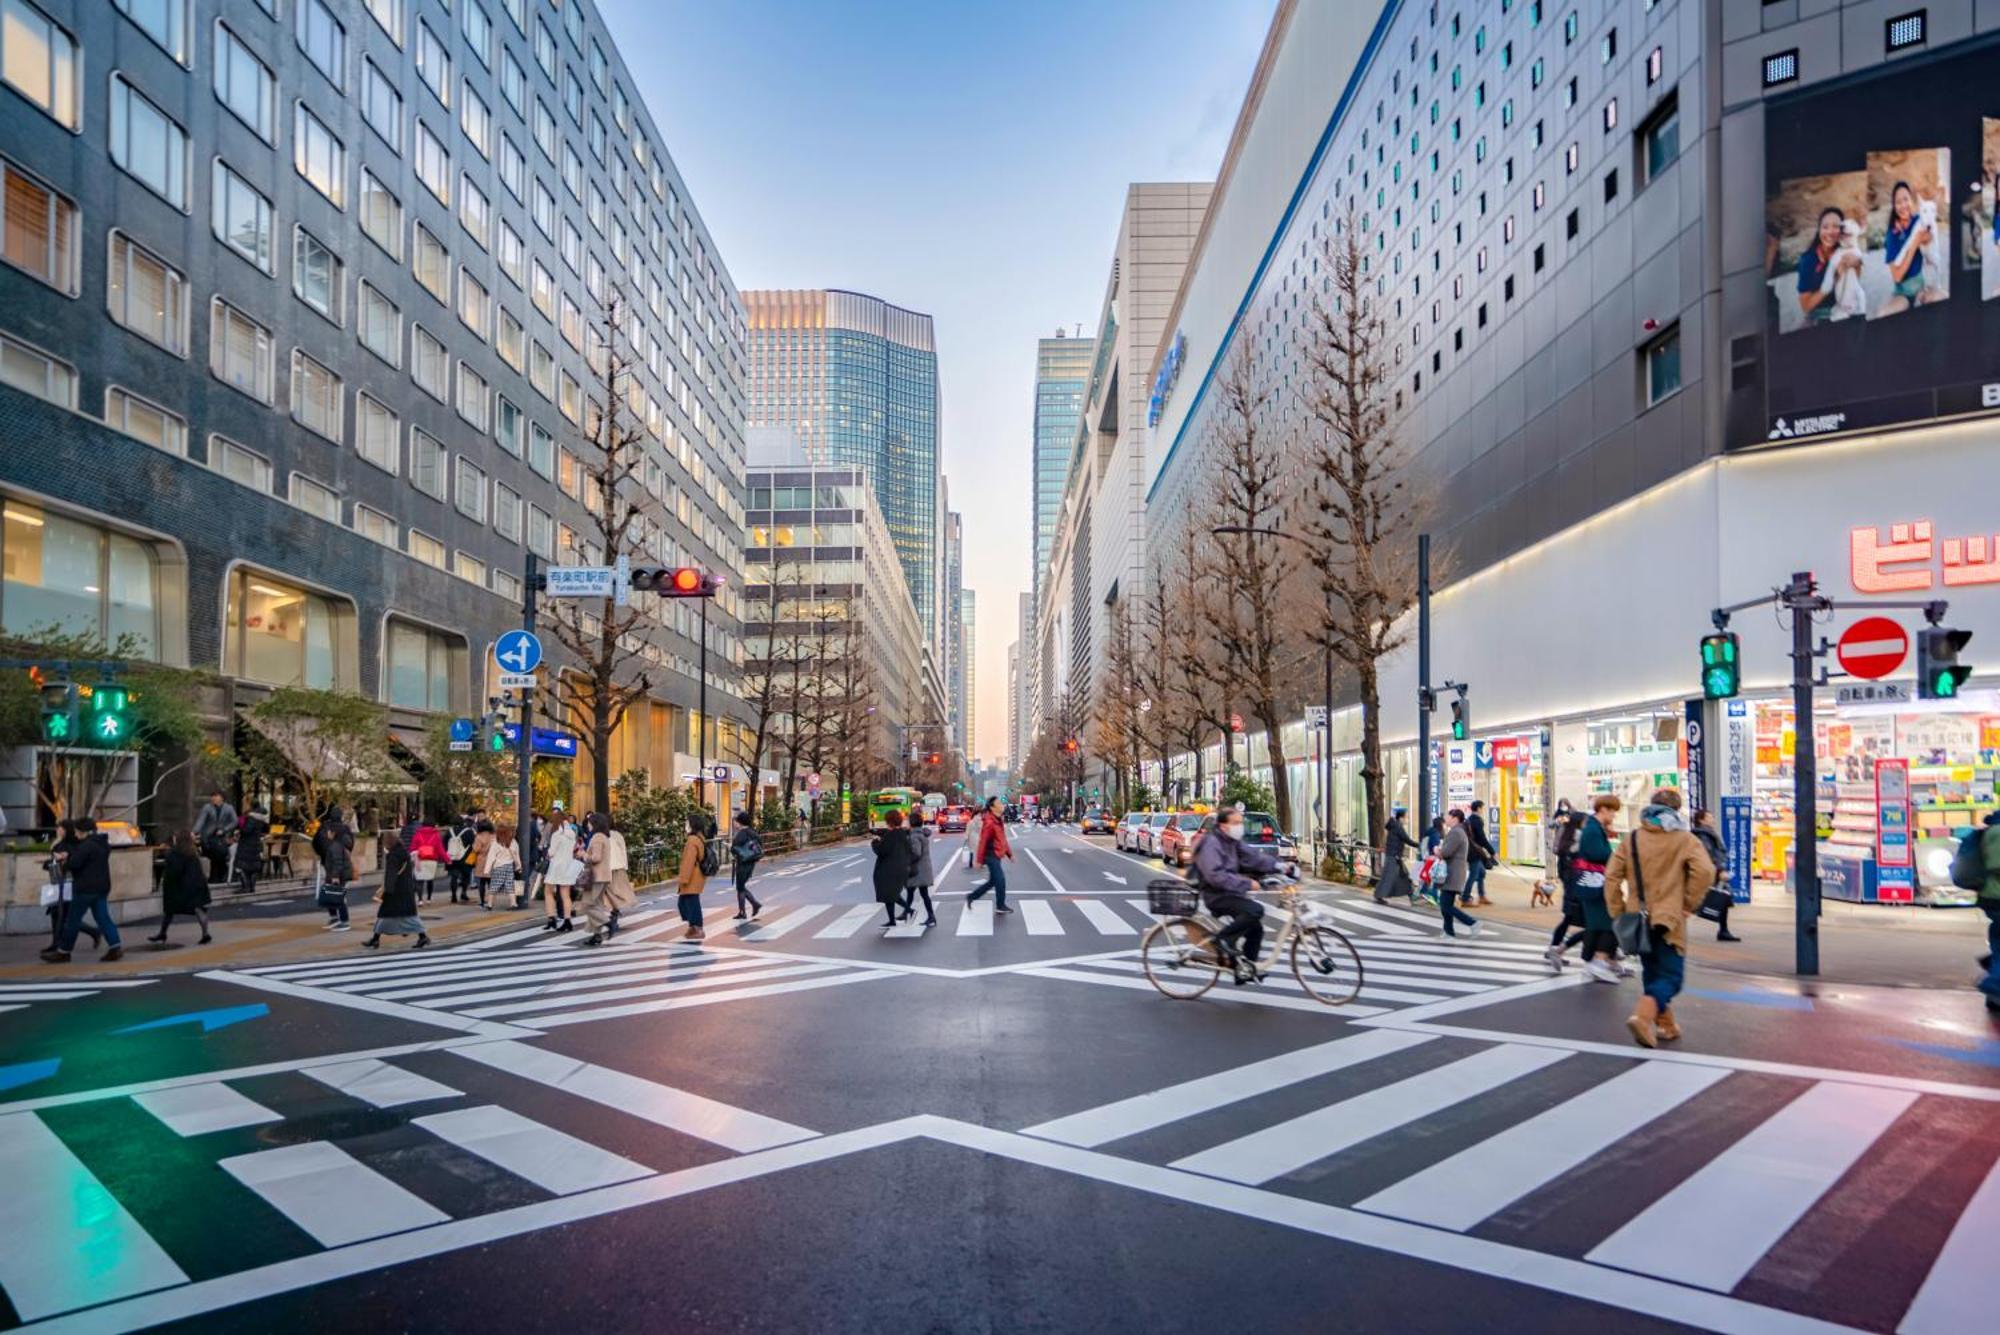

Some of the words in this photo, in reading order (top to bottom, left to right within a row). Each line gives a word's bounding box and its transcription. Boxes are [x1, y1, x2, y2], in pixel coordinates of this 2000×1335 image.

[1851, 520, 2000, 592] ビッ
[550, 571, 609, 583] 有楽町駅前
[1839, 685, 1906, 701] 自転車を除く
